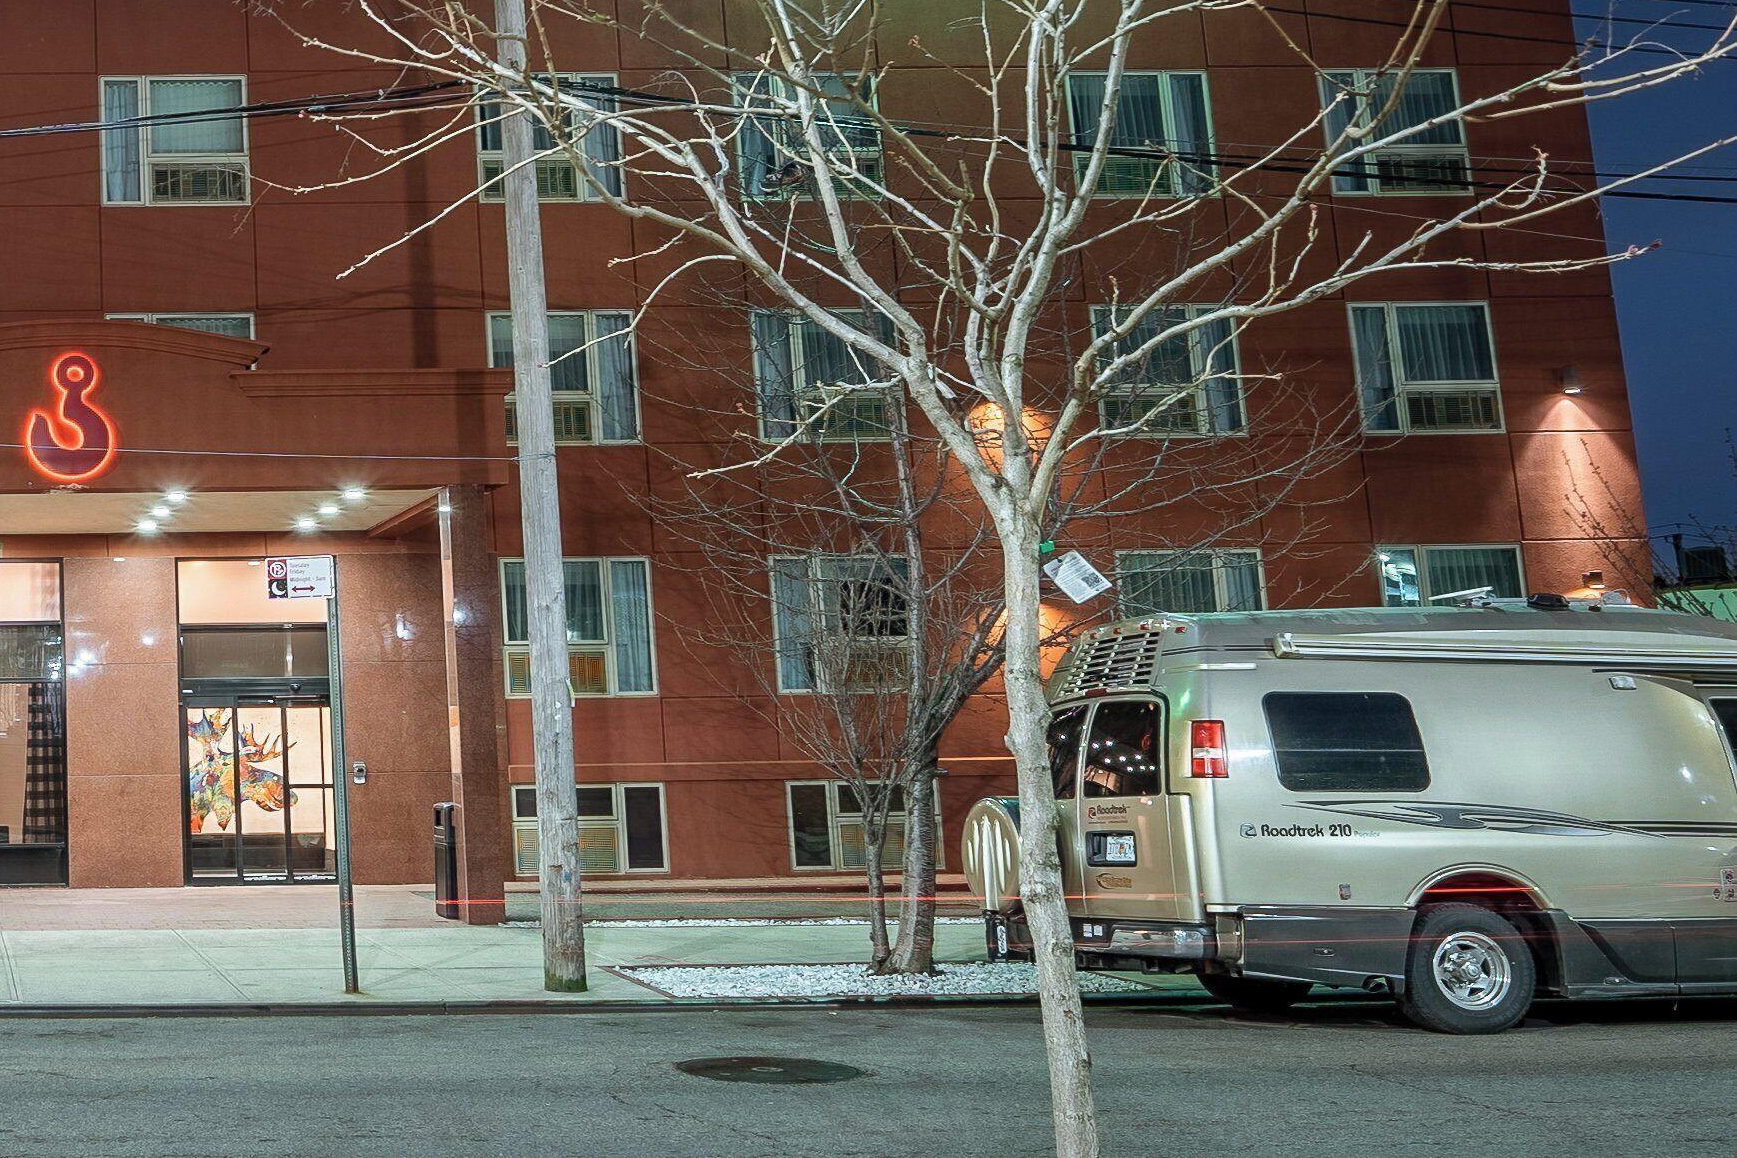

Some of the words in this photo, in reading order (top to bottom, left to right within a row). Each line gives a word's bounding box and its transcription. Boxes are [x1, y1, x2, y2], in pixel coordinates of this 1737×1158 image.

[1097, 803, 1128, 814] Roadtrek
[1260, 824, 1324, 837] Roadtrek
[1328, 823, 1352, 837] 210
